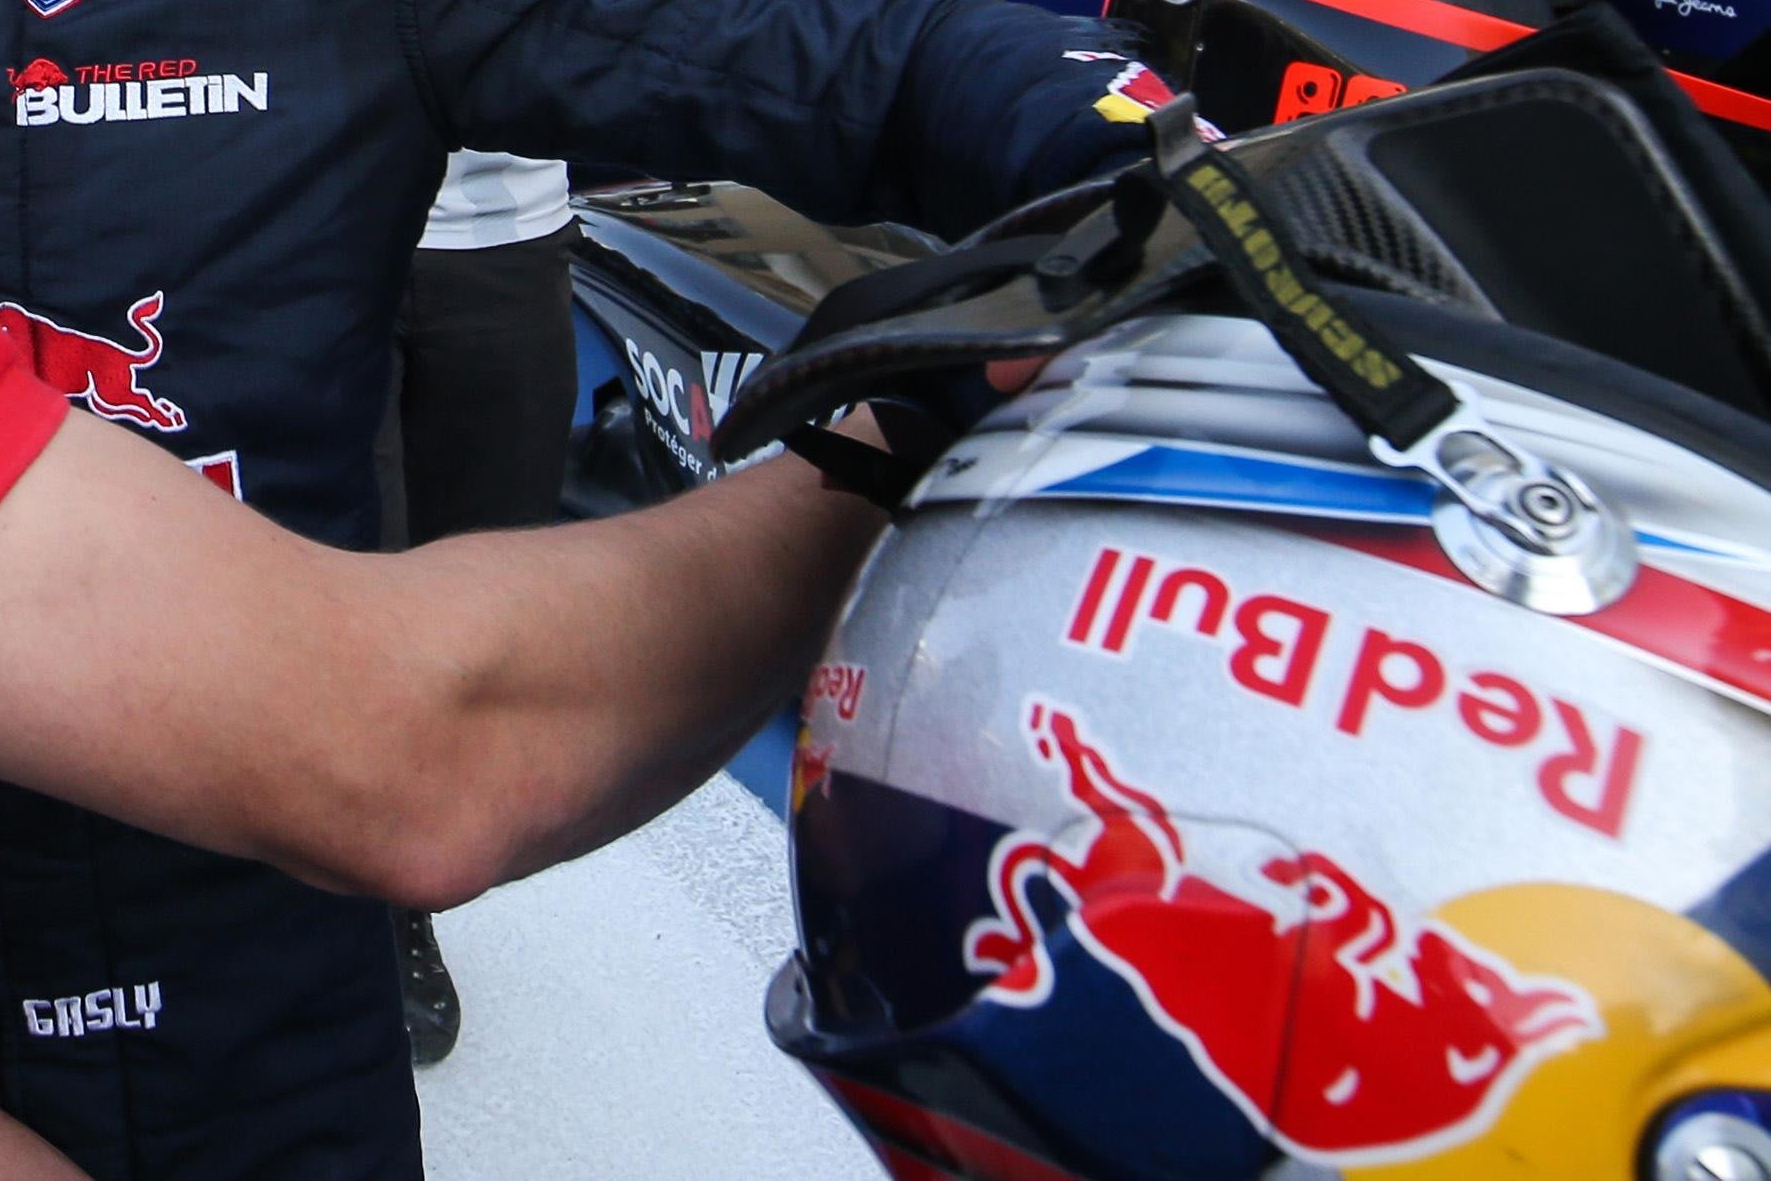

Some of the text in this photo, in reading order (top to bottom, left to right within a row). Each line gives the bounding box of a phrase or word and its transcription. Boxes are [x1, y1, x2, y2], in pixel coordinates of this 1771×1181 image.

[75, 58, 197, 84] THE RED
[1065, 545, 1648, 842] Red Bull
[22, 980, 163, 1037] GASLY
